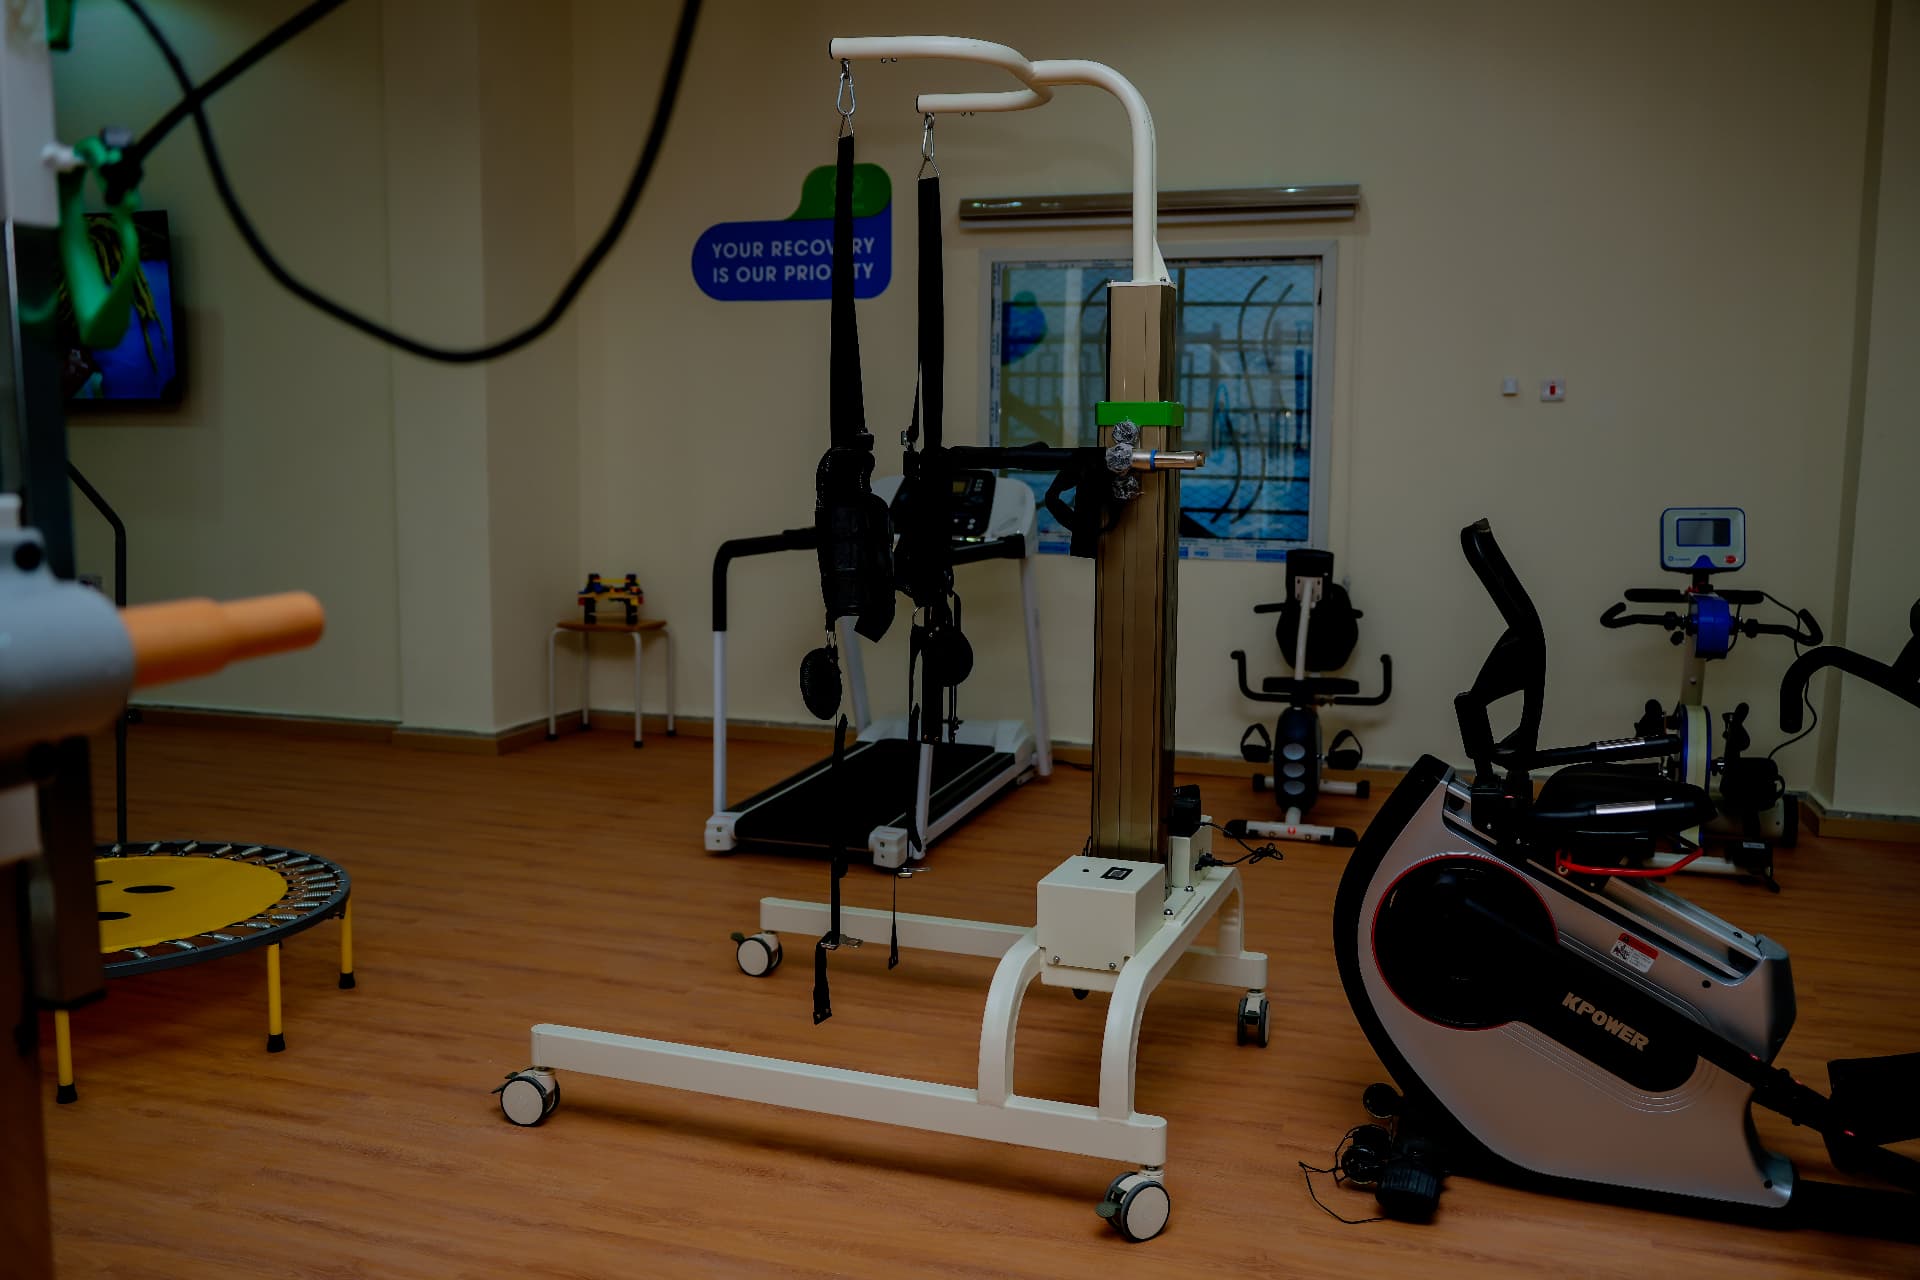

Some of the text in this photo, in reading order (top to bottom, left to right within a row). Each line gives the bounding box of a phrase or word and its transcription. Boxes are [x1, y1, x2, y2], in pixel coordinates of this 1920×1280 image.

[712, 237, 875, 259] YOUR RECOVRY
[713, 262, 874, 284] IS OUR PRIOTY
[1561, 991, 1650, 1053] KPOWER
